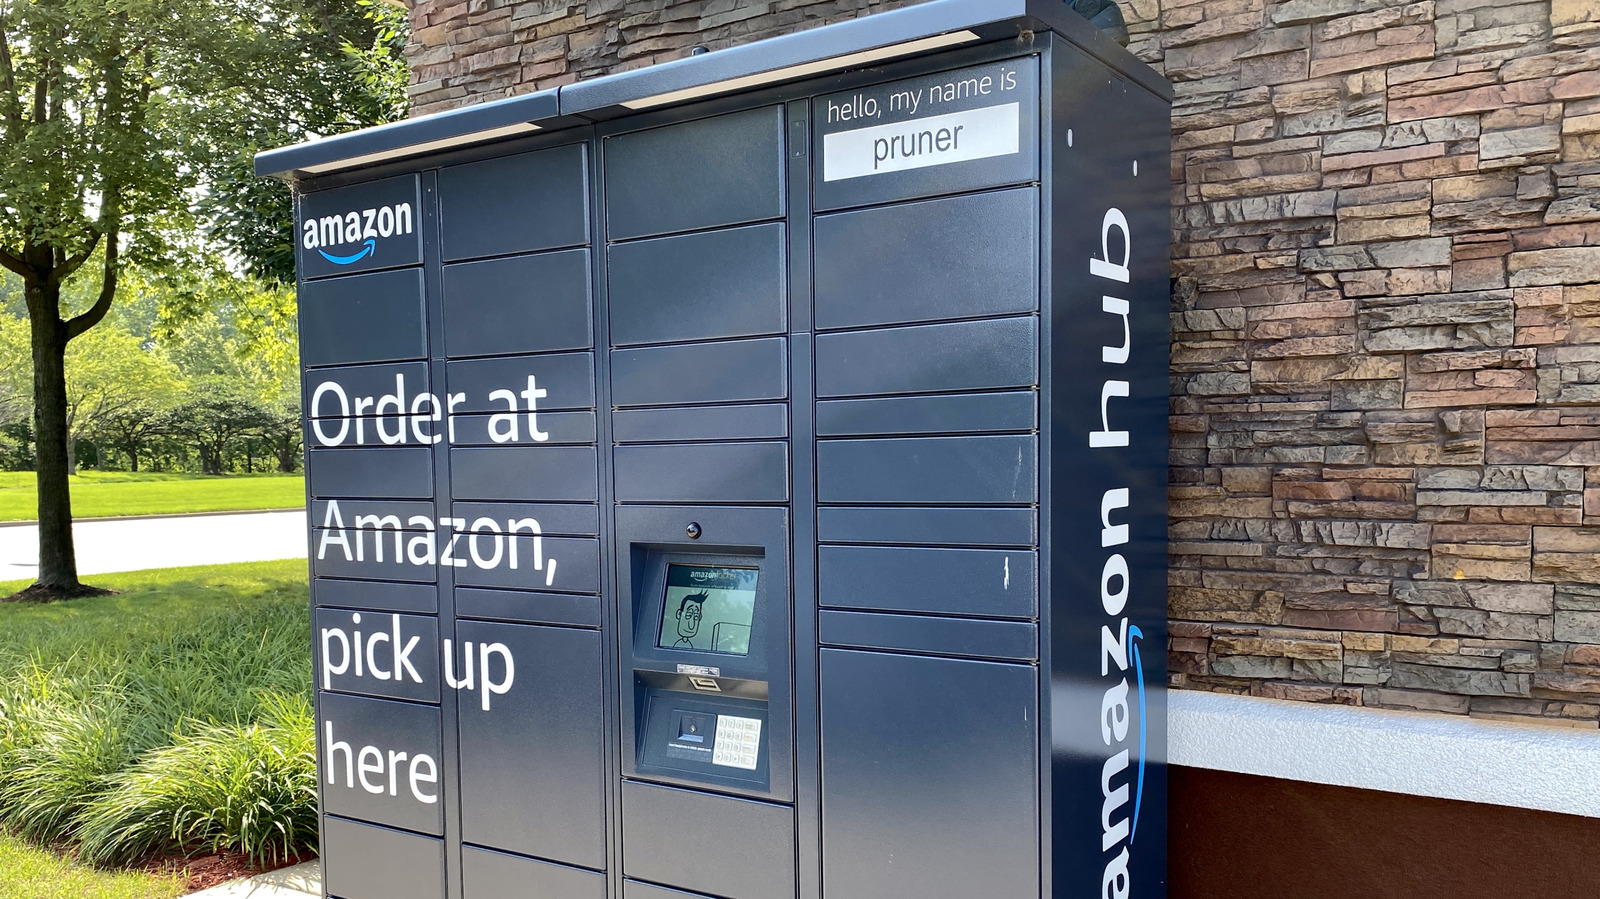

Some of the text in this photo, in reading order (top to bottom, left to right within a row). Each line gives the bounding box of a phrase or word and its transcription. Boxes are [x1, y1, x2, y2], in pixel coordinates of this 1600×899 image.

[827, 67, 1017, 124] hello, my name is
[873, 125, 964, 170] pruner
[303, 202, 412, 250] amazon
[311, 373, 549, 447] Order at
[318, 499, 557, 586] Amazon,
[1089, 207, 1131, 899] amazon hub
[321, 612, 515, 711] pick up
[325, 720, 438, 804] here
